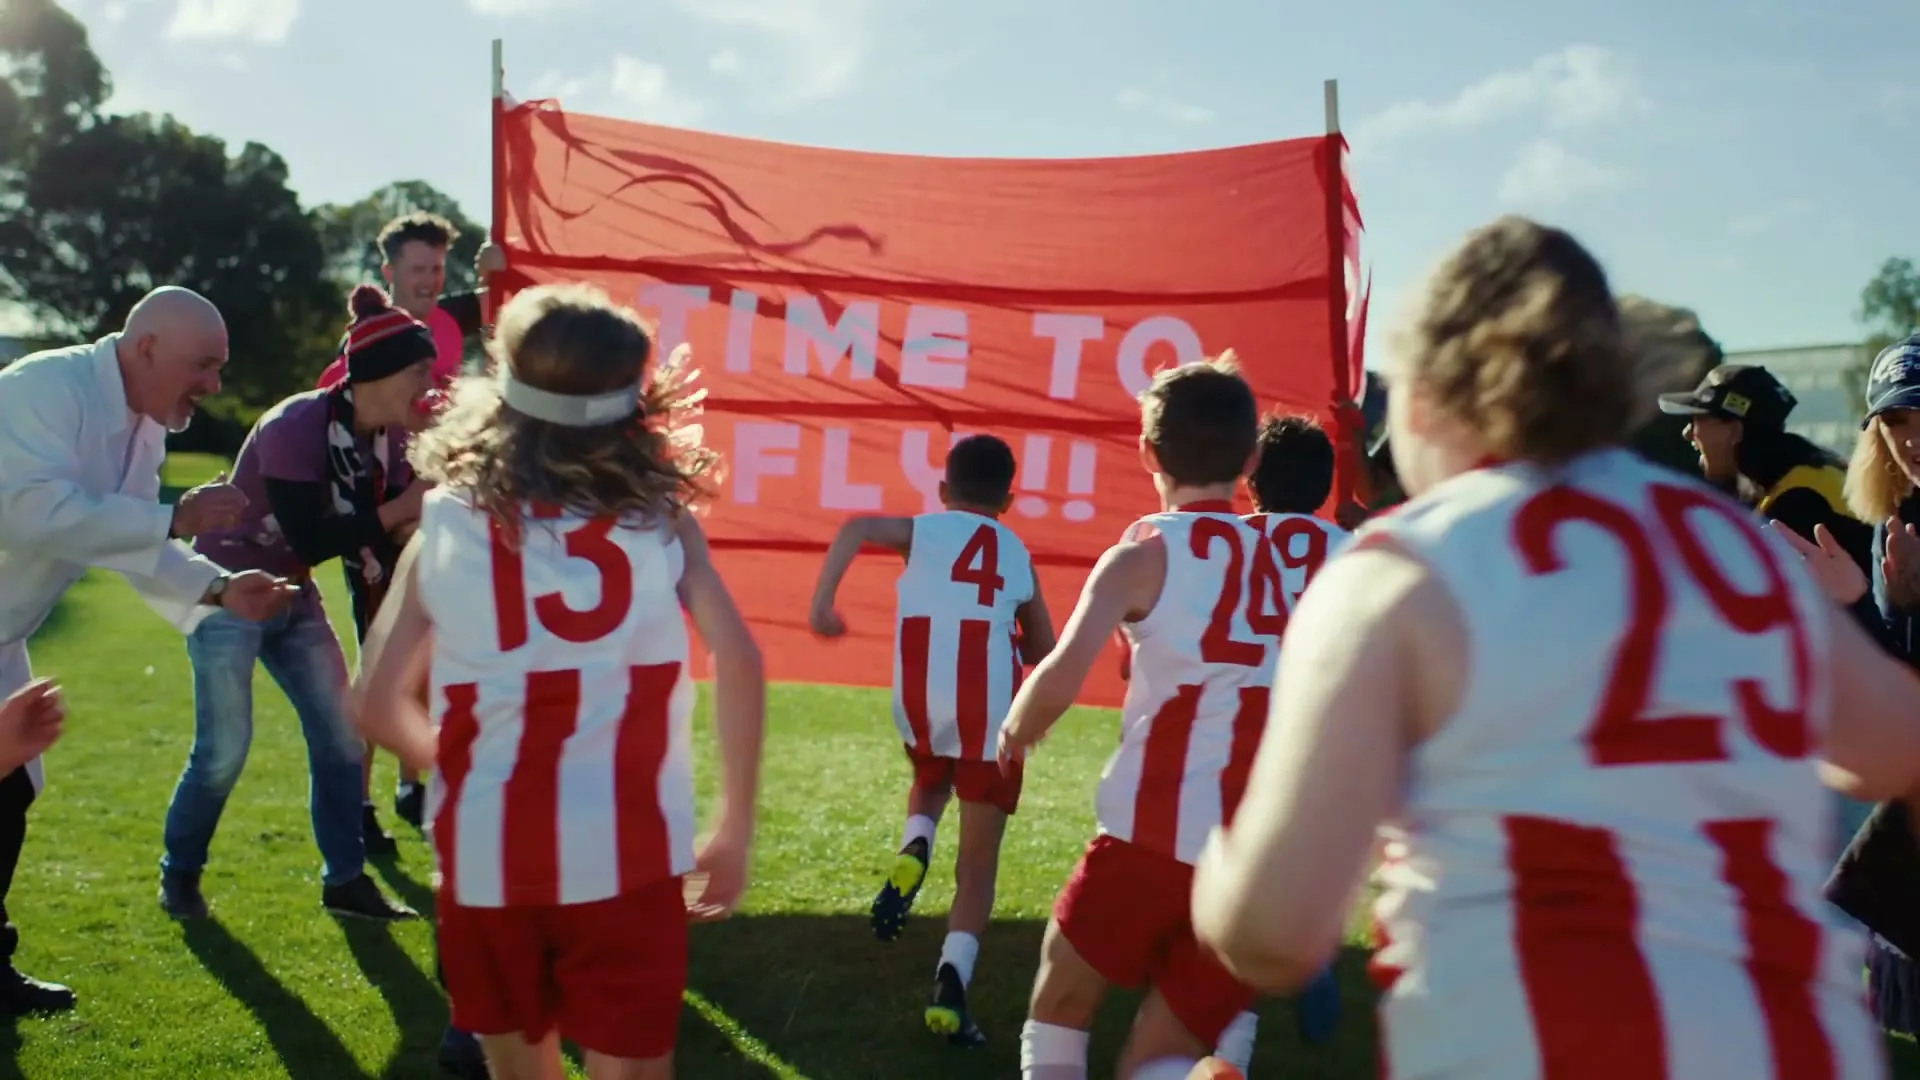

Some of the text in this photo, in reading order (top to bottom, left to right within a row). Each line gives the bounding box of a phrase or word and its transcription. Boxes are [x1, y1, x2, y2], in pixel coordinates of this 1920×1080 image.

[639, 284, 1203, 400] TIME TO
[479, 498, 634, 652] 13
[951, 523, 1004, 607] 4
[1510, 482, 1813, 767] 29
